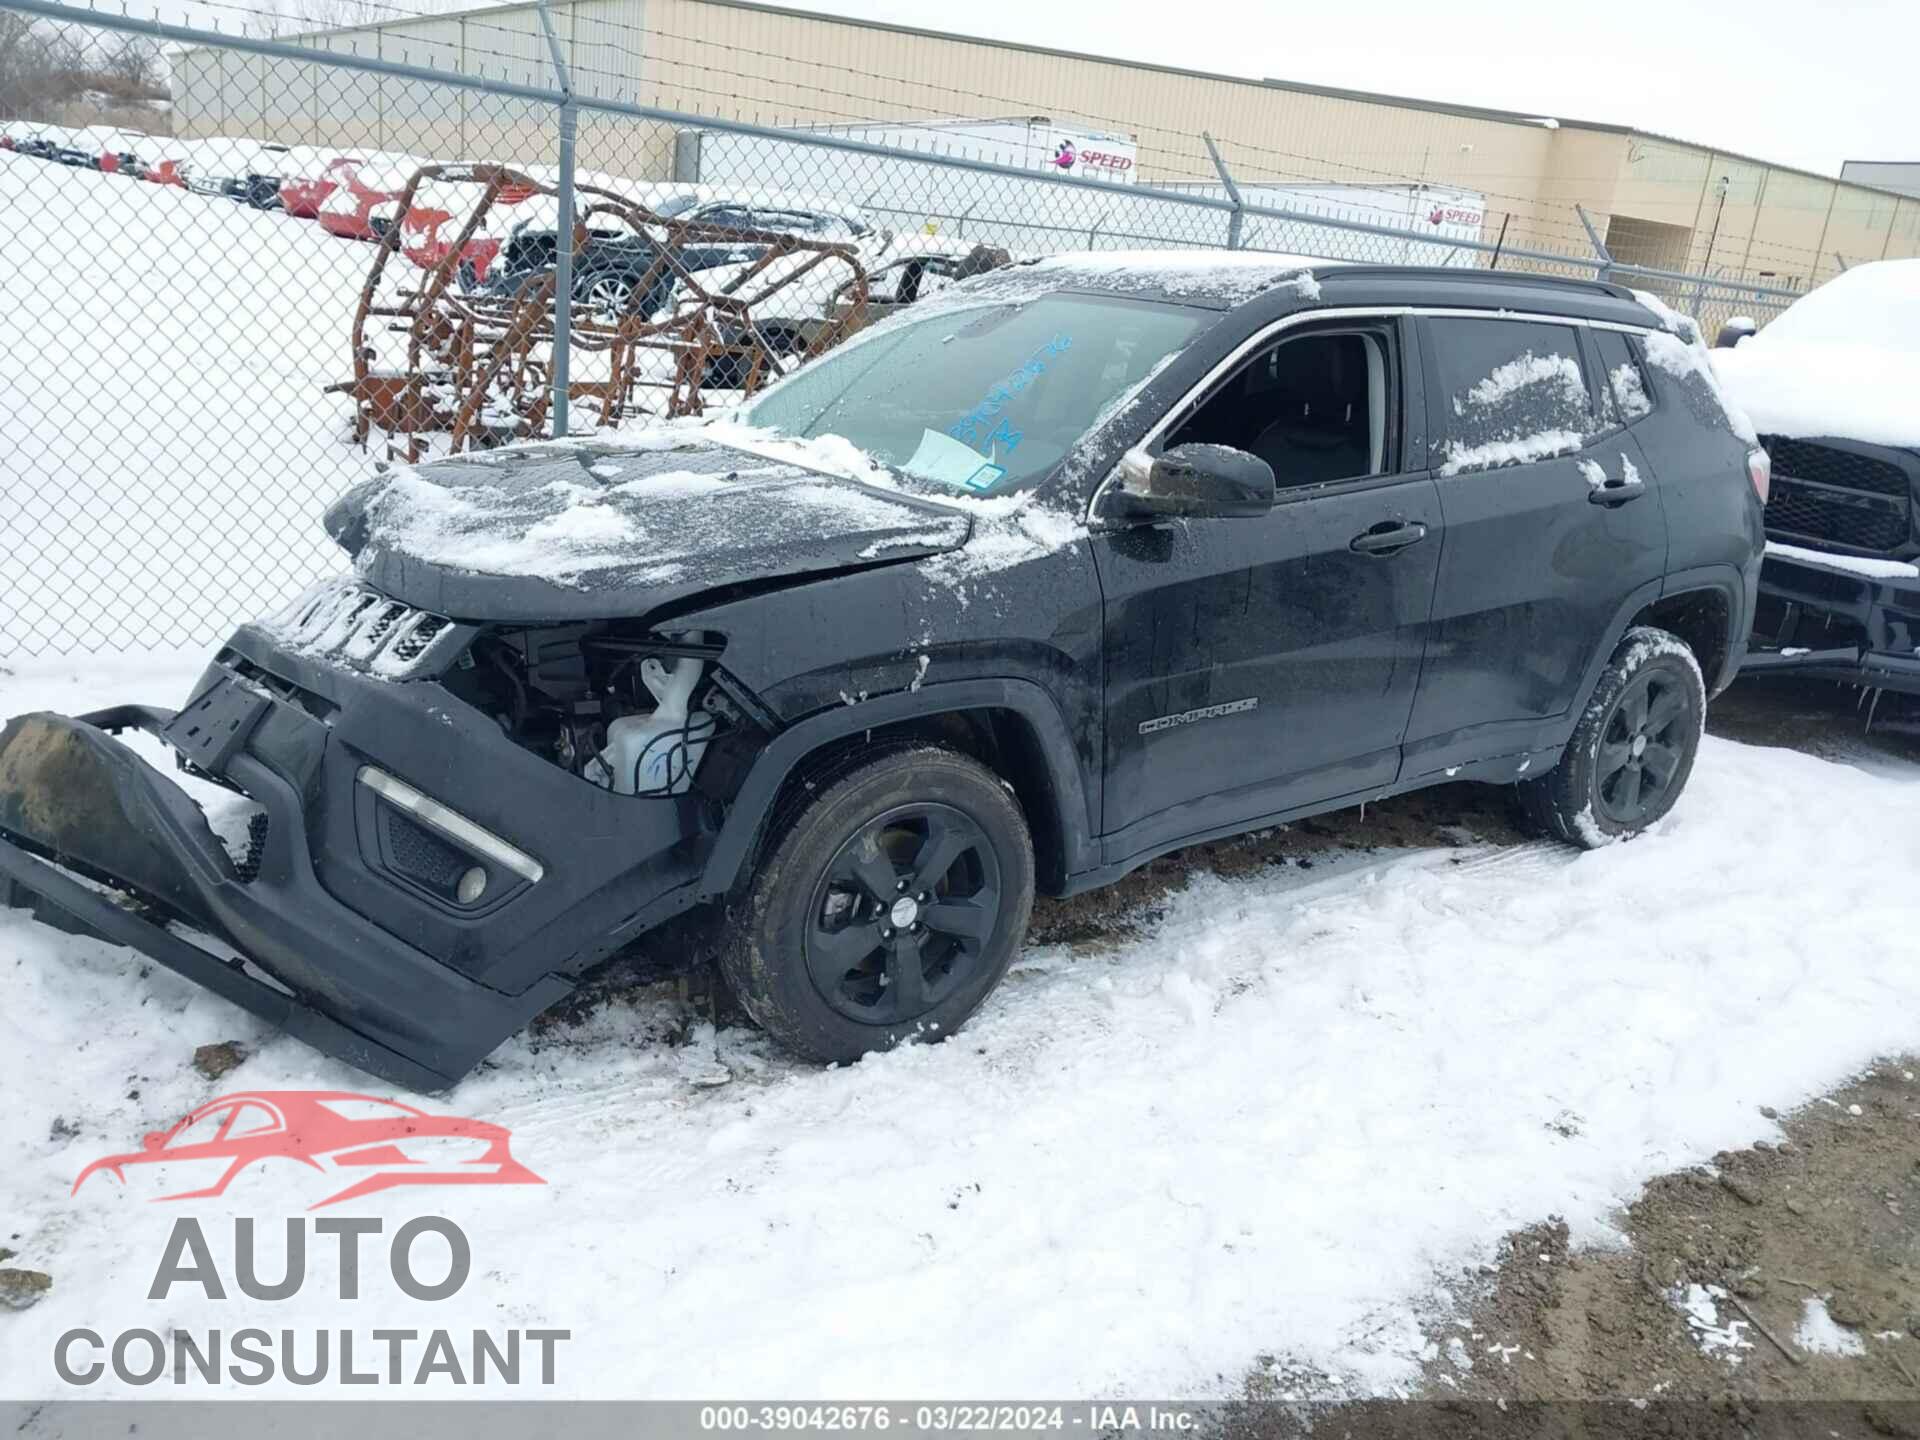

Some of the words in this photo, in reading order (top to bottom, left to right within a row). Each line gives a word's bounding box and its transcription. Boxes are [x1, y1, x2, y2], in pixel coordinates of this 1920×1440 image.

[1080, 150, 1132, 170] SPEED
[1445, 209, 1481, 224] SPEED
[1138, 697, 1258, 734] COMPASS
